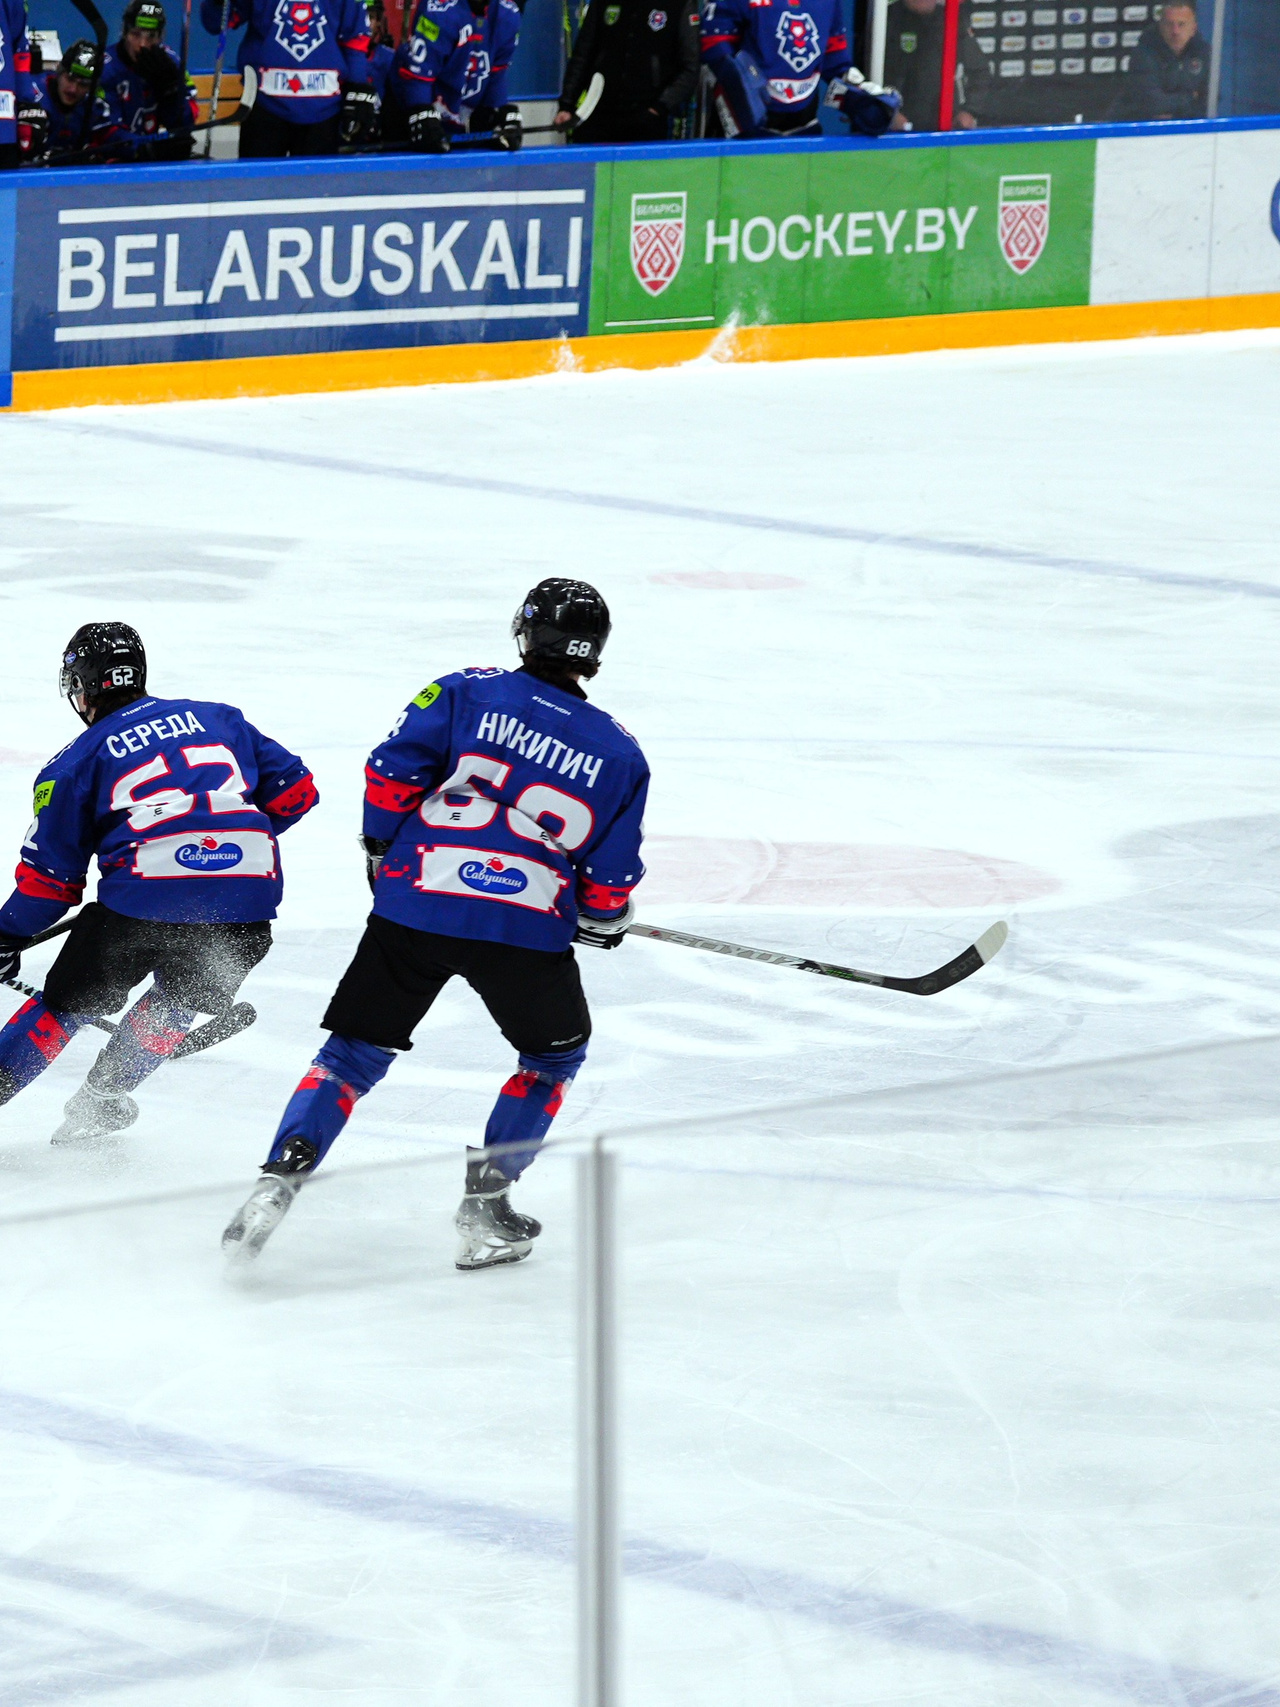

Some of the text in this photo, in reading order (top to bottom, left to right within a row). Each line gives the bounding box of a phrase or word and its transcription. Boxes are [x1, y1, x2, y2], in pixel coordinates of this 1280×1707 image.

[705, 206, 978, 263] HOCKEY.BY
[57, 216, 583, 312] BELARUSKALI
[566, 640, 592, 658] 68
[111, 668, 134, 687] 62
[106, 710, 207, 758] СЕРЕДА
[476, 711, 603, 788] НИКИТИЧ
[178, 847, 238, 865] Савушкин
[462, 864, 523, 888] Савушкин
